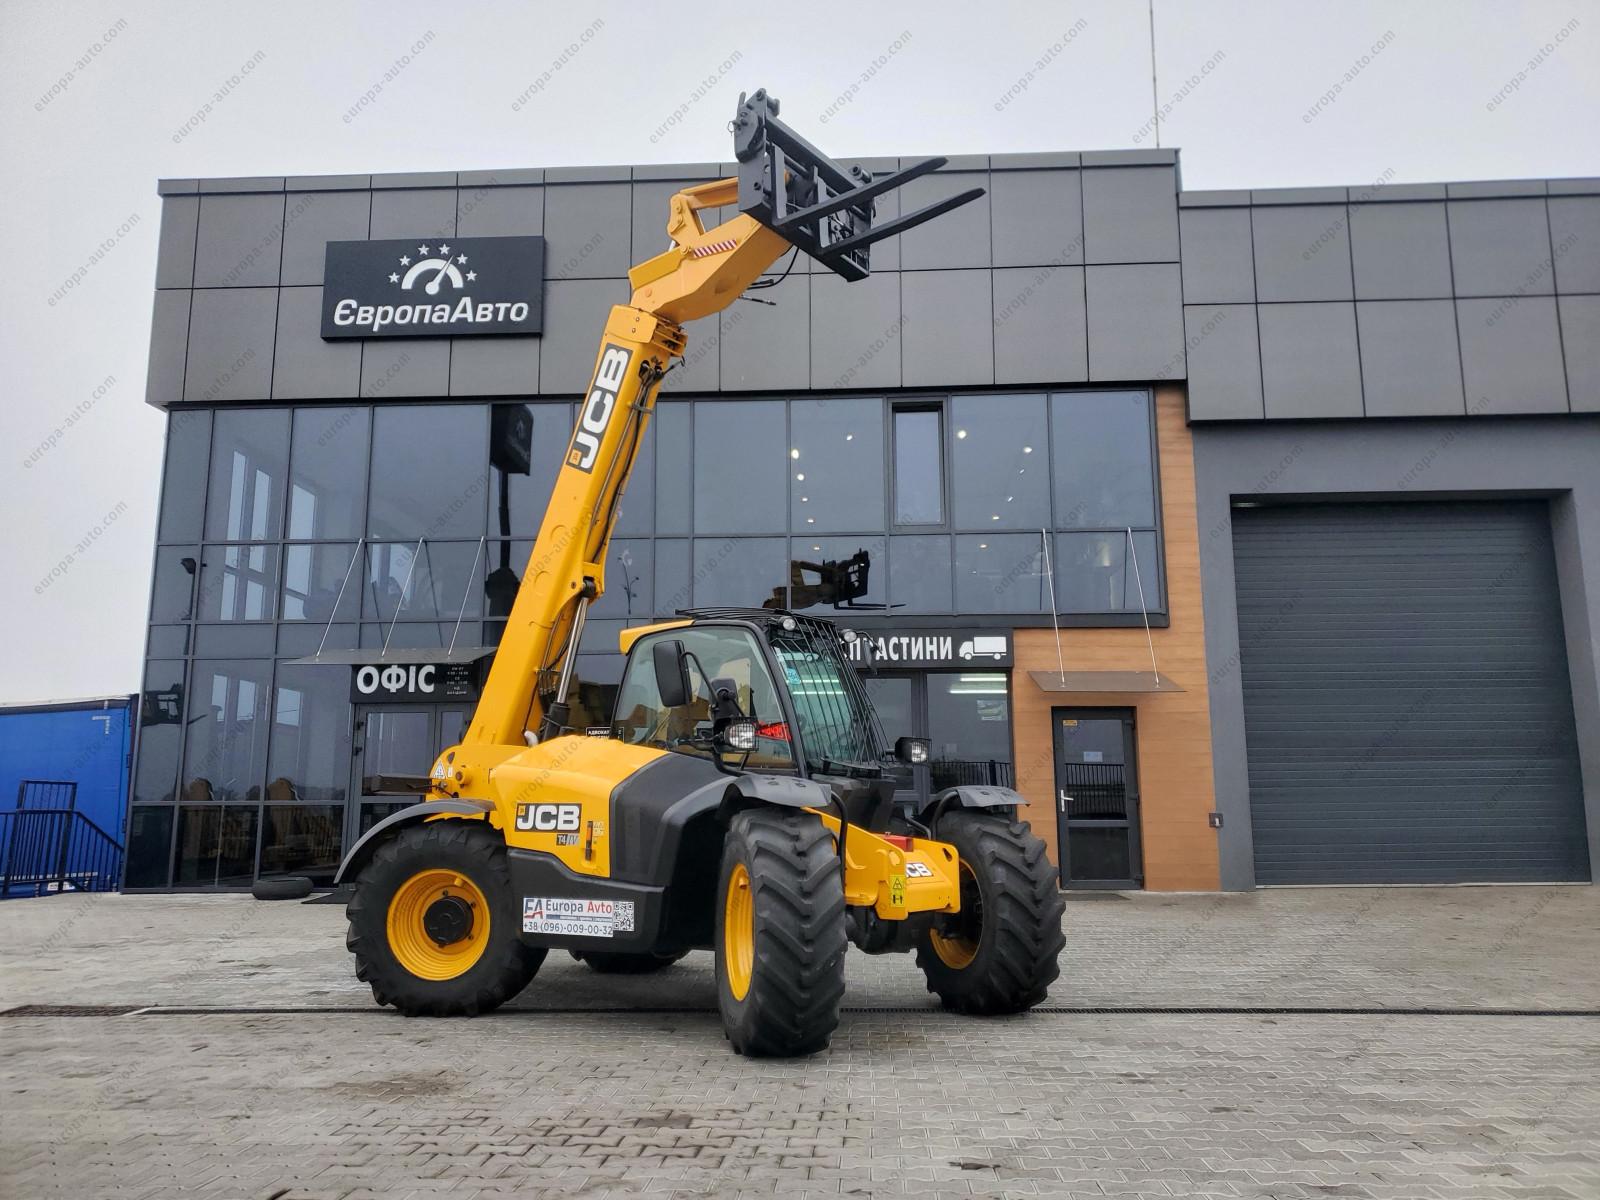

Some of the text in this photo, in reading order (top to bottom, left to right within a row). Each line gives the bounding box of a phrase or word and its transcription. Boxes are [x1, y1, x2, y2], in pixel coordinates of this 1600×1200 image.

[334, 296, 529, 332] ЄвропаАвто
[575, 347, 630, 469] JCB
[838, 636, 953, 661] ПАСТИНИ
[356, 664, 436, 694] ОФІС
[516, 804, 580, 831] JCB
[906, 863, 933, 877] CB
[546, 899, 583, 914] Europa
[587, 901, 612, 914] Avto
[524, 921, 538, 931] +38
